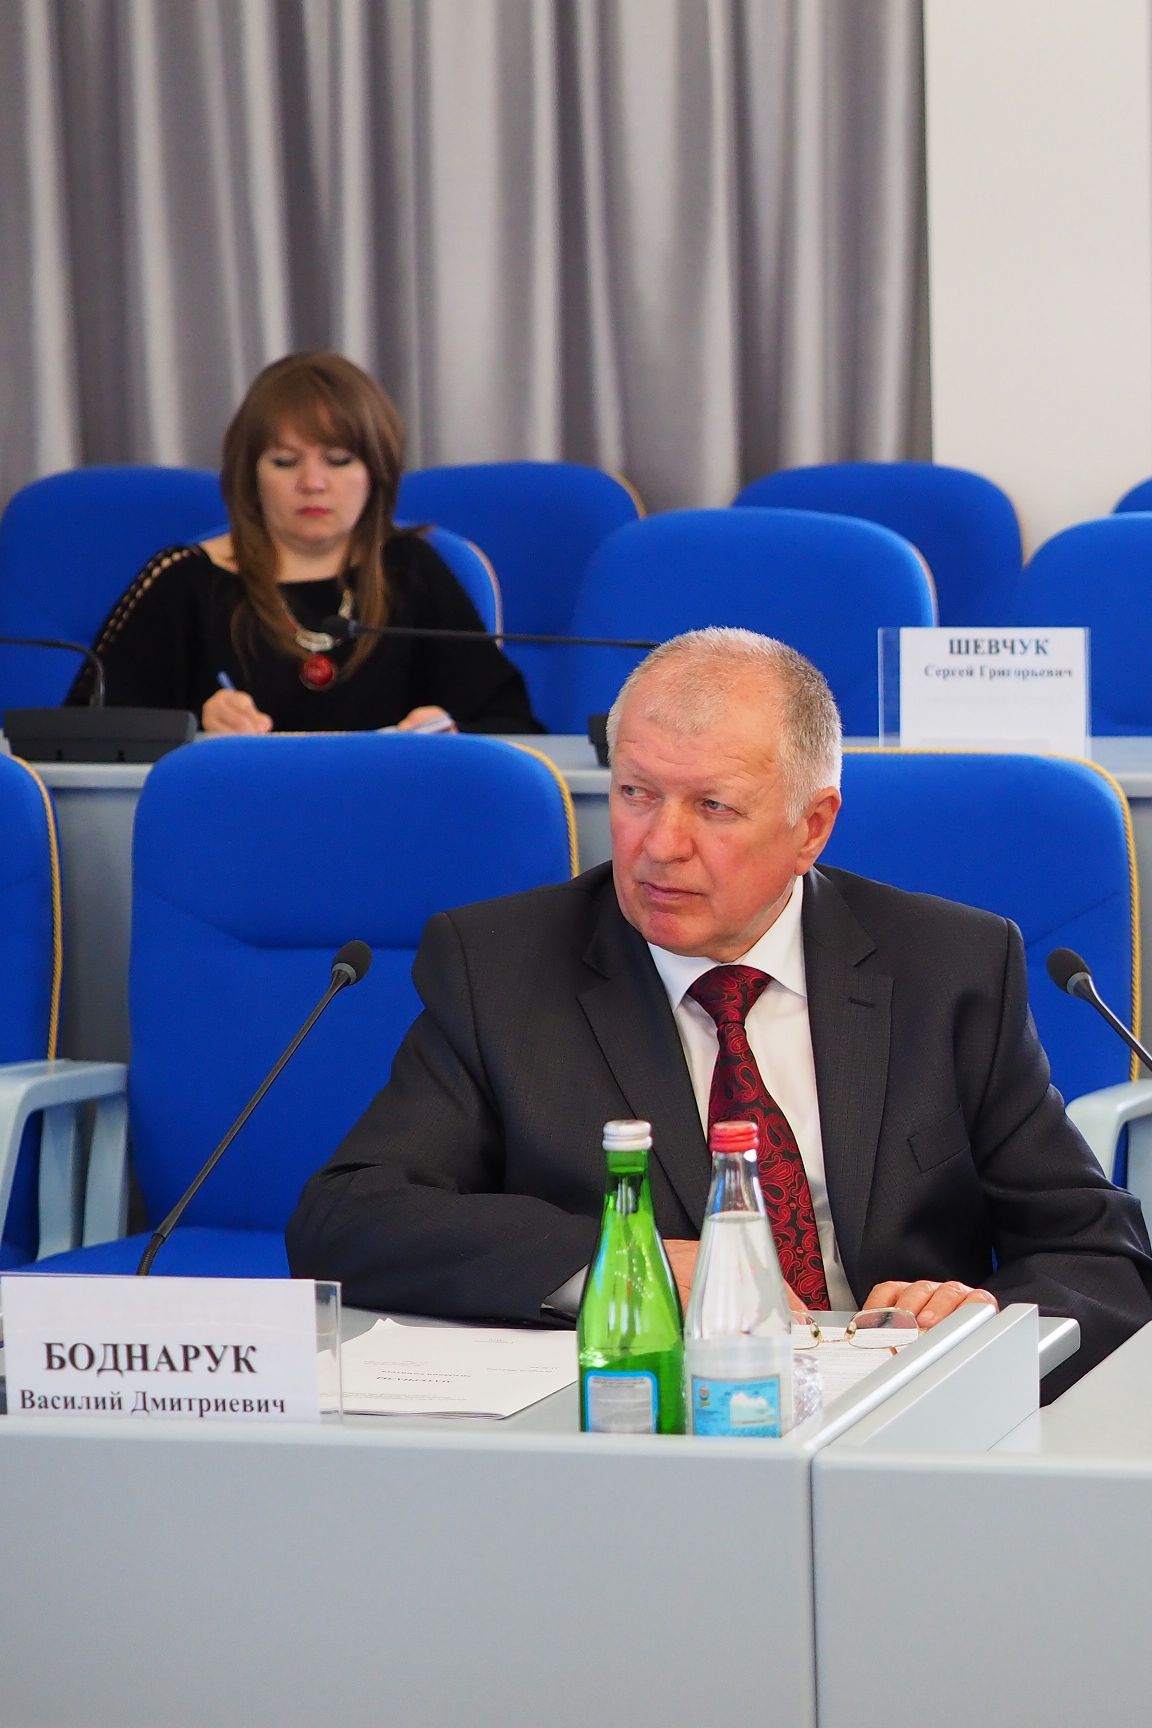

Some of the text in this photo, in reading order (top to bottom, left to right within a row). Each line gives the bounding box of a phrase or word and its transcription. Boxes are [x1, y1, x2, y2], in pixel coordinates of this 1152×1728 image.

[949, 638, 1049, 655] ШЕВЧУК
[924, 664, 1073, 680] Сергей Григорьевич
[44, 1342, 258, 1375] БОДНАРУК
[20, 1388, 286, 1418] Василий Дмитриевич
